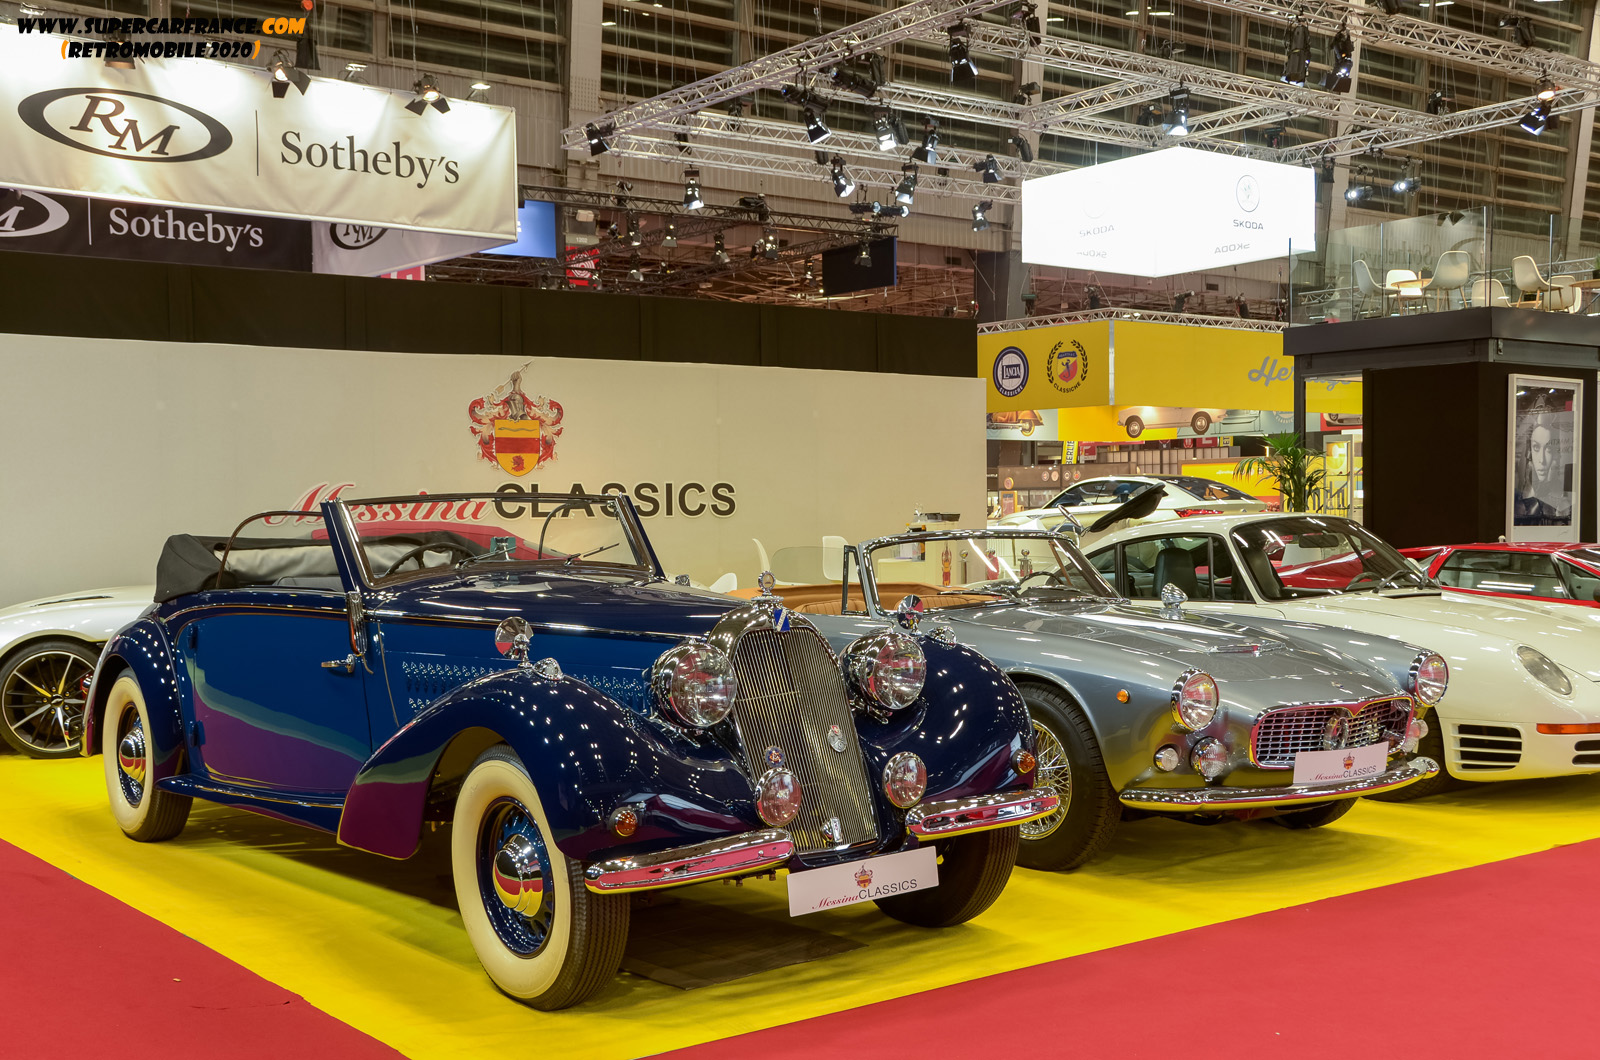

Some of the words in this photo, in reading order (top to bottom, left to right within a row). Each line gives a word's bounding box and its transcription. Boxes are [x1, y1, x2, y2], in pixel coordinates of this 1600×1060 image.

[69, 95, 181, 156] RM
[281, 130, 460, 189] Sotheby's
[109, 207, 264, 252] Sotheby's
[1232, 219, 1264, 230] SKODA
[1003, 366, 1021, 380] LANCIA
[999, 384, 1024, 397] CLASSICHE
[1053, 381, 1082, 394] CLASSICHE
[264, 483, 491, 525] Mssina
[858, 878, 918, 900] CLASSICS
